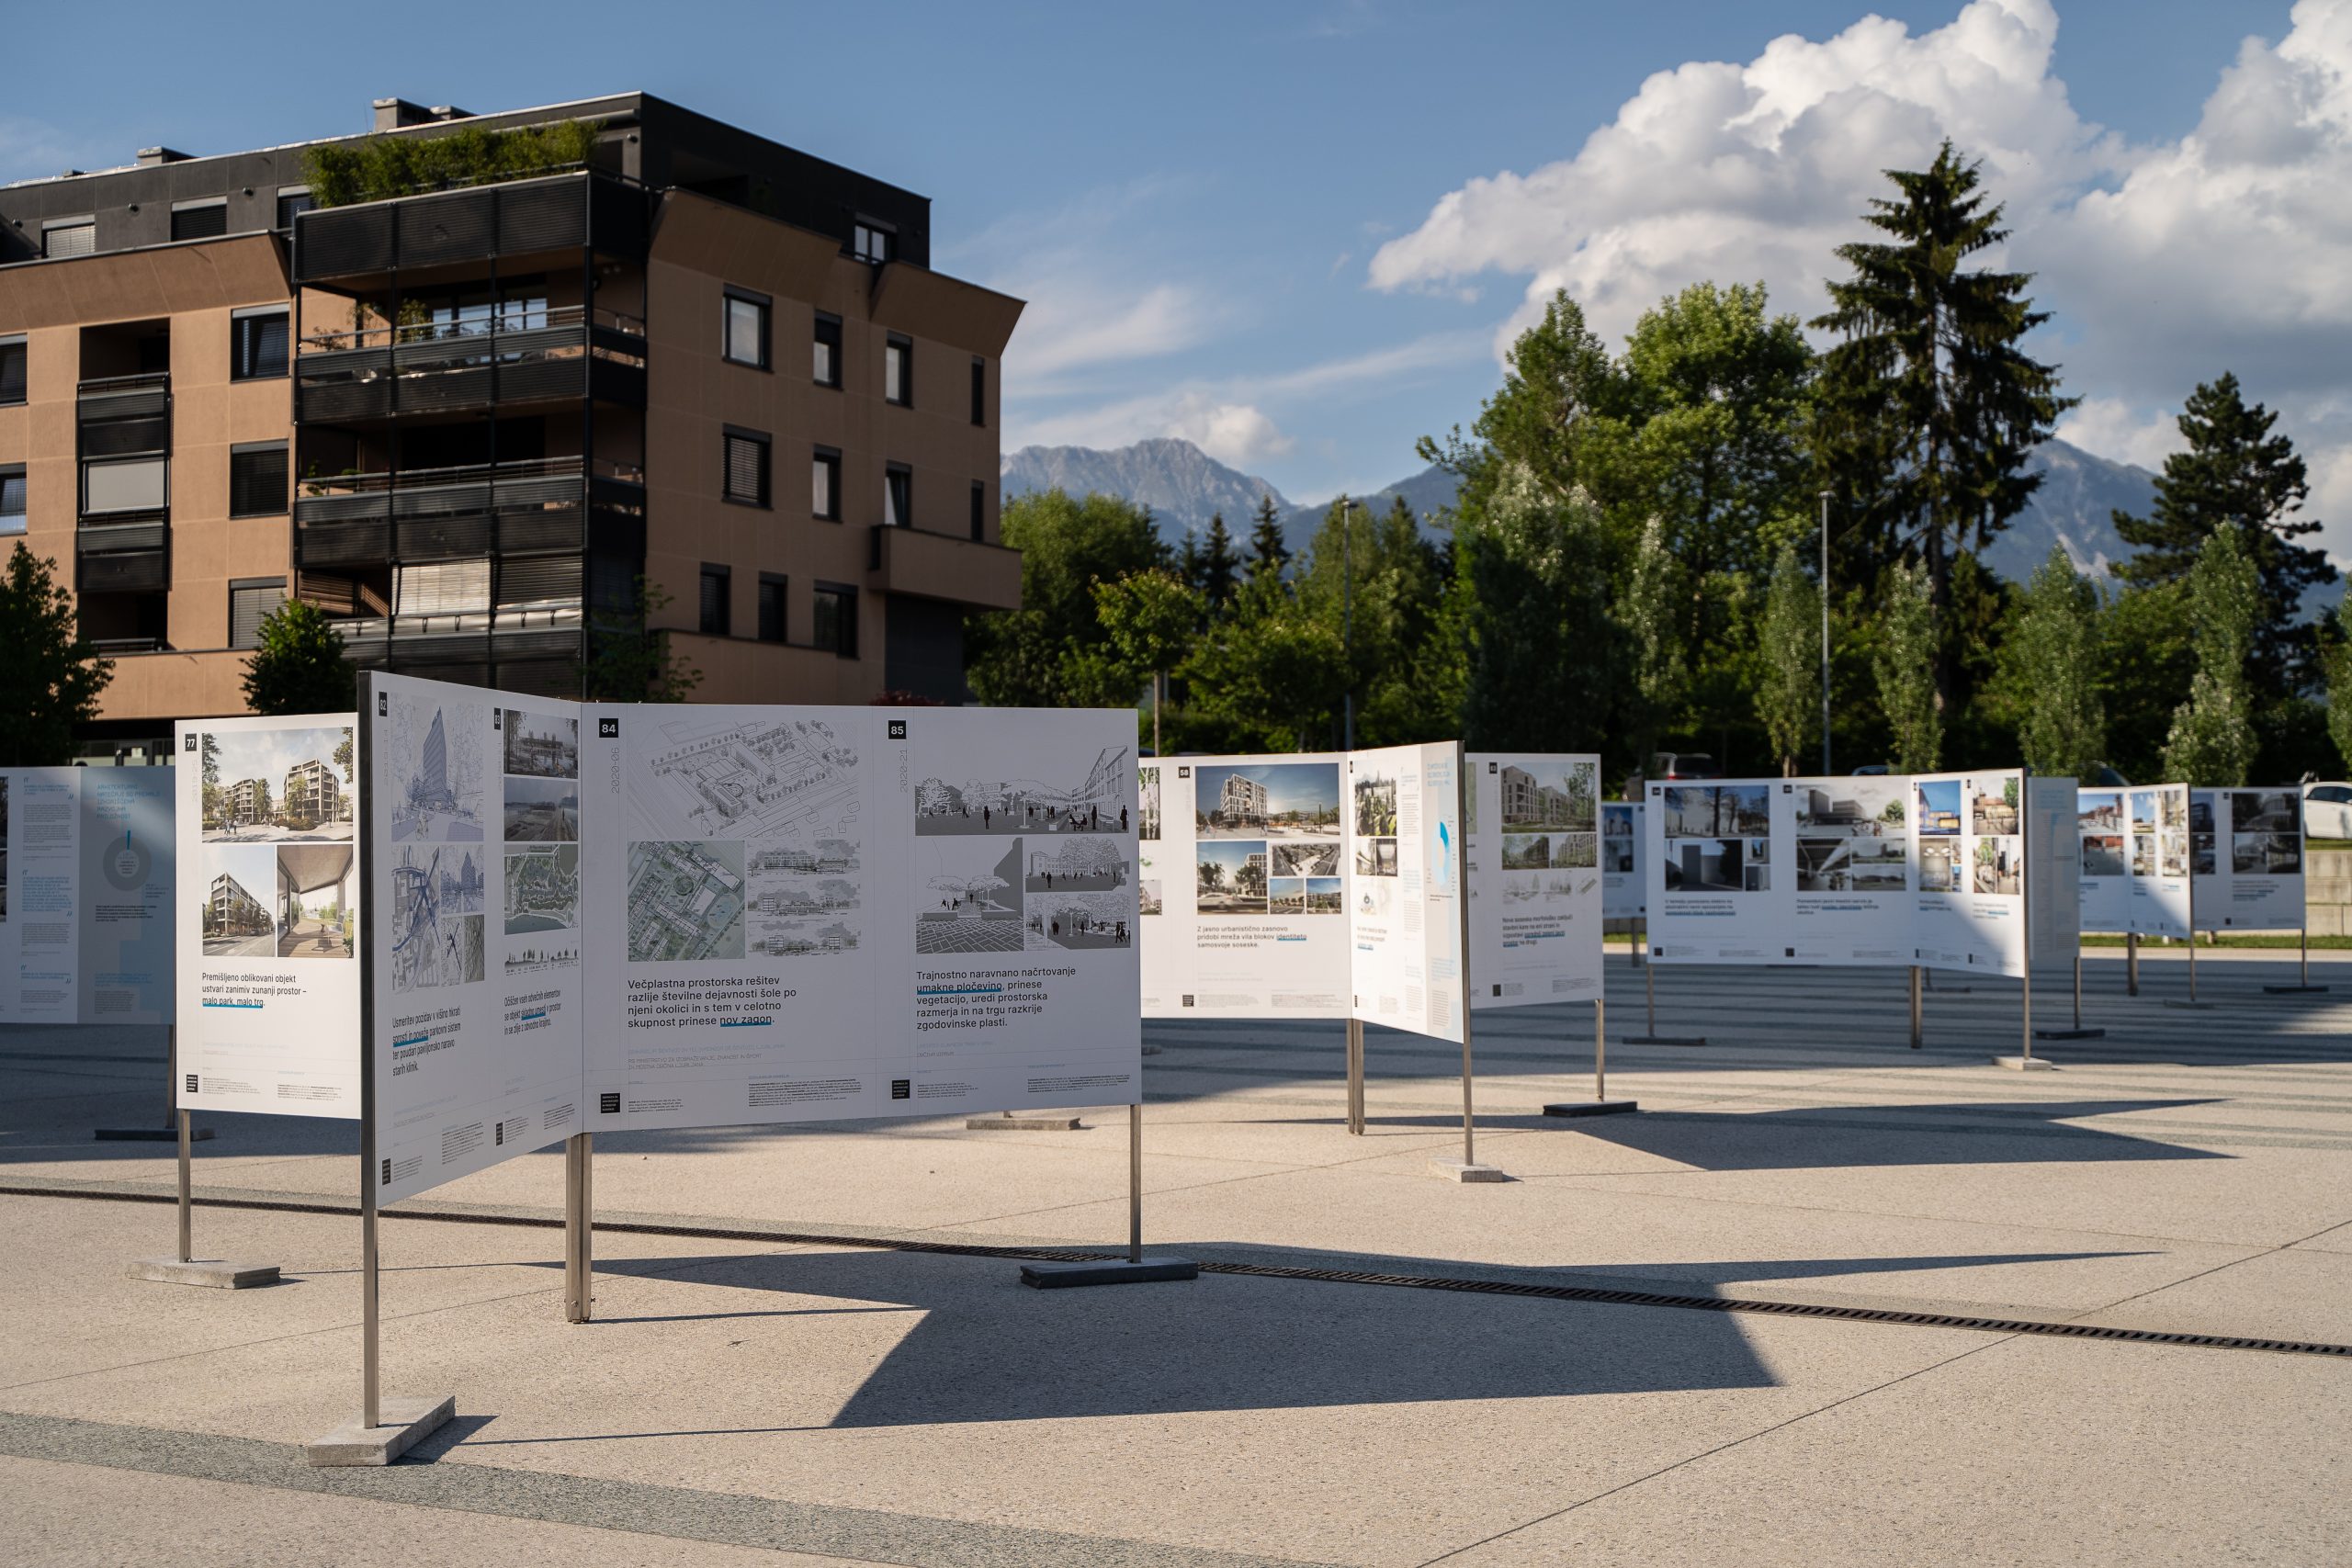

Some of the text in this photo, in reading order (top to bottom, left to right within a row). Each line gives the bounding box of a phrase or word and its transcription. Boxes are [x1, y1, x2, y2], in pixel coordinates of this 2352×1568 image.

[602, 724, 616, 733] 84
[891, 726, 904, 735] 85
[187, 739, 196, 748] 77
[611, 747, 620, 794] 2020-06
[899, 750, 908, 793] 2020-21
[202, 972, 297, 985] Premišljeno oblikovani objekt
[917, 966, 1076, 981] Trajnostno naravnano načrtovanje
[628, 976, 780, 990] Večplastna prostorska rešitev
[917, 980, 1042, 993] umakne pločevino, prinese
[202, 985, 224, 994] ustvari
[226, 985, 251, 995] zanimiv
[252, 987, 276, 997] zunanji
[277, 987, 301, 997] prostor
[628, 988, 797, 1003] razlije številne dejavnosti šole po
[202, 997, 218, 1005] malo
[237, 998, 253, 1006] malo
[917, 992, 1048, 1006] vegetacijo, uredi prostorska
[628, 1005, 653, 1017] njeni
[656, 1003, 689, 1014] okolici
[692, 1003, 701, 1013] in
[713, 1003, 732, 1012] tem
[735, 1003, 741, 1011] v
[743, 1001, 782, 1011] celotno
[917, 1004, 1043, 1018] razmerja in na trgu razkrije
[392, 1014, 415, 1029] Usmeritev
[415, 1011, 433, 1026] pozidav
[436, 1009, 448, 1020] višino
[628, 1015, 775, 1029] skupnost prinese nov zagon.
[917, 1018, 1008, 1032] zgodovinske plasti.
